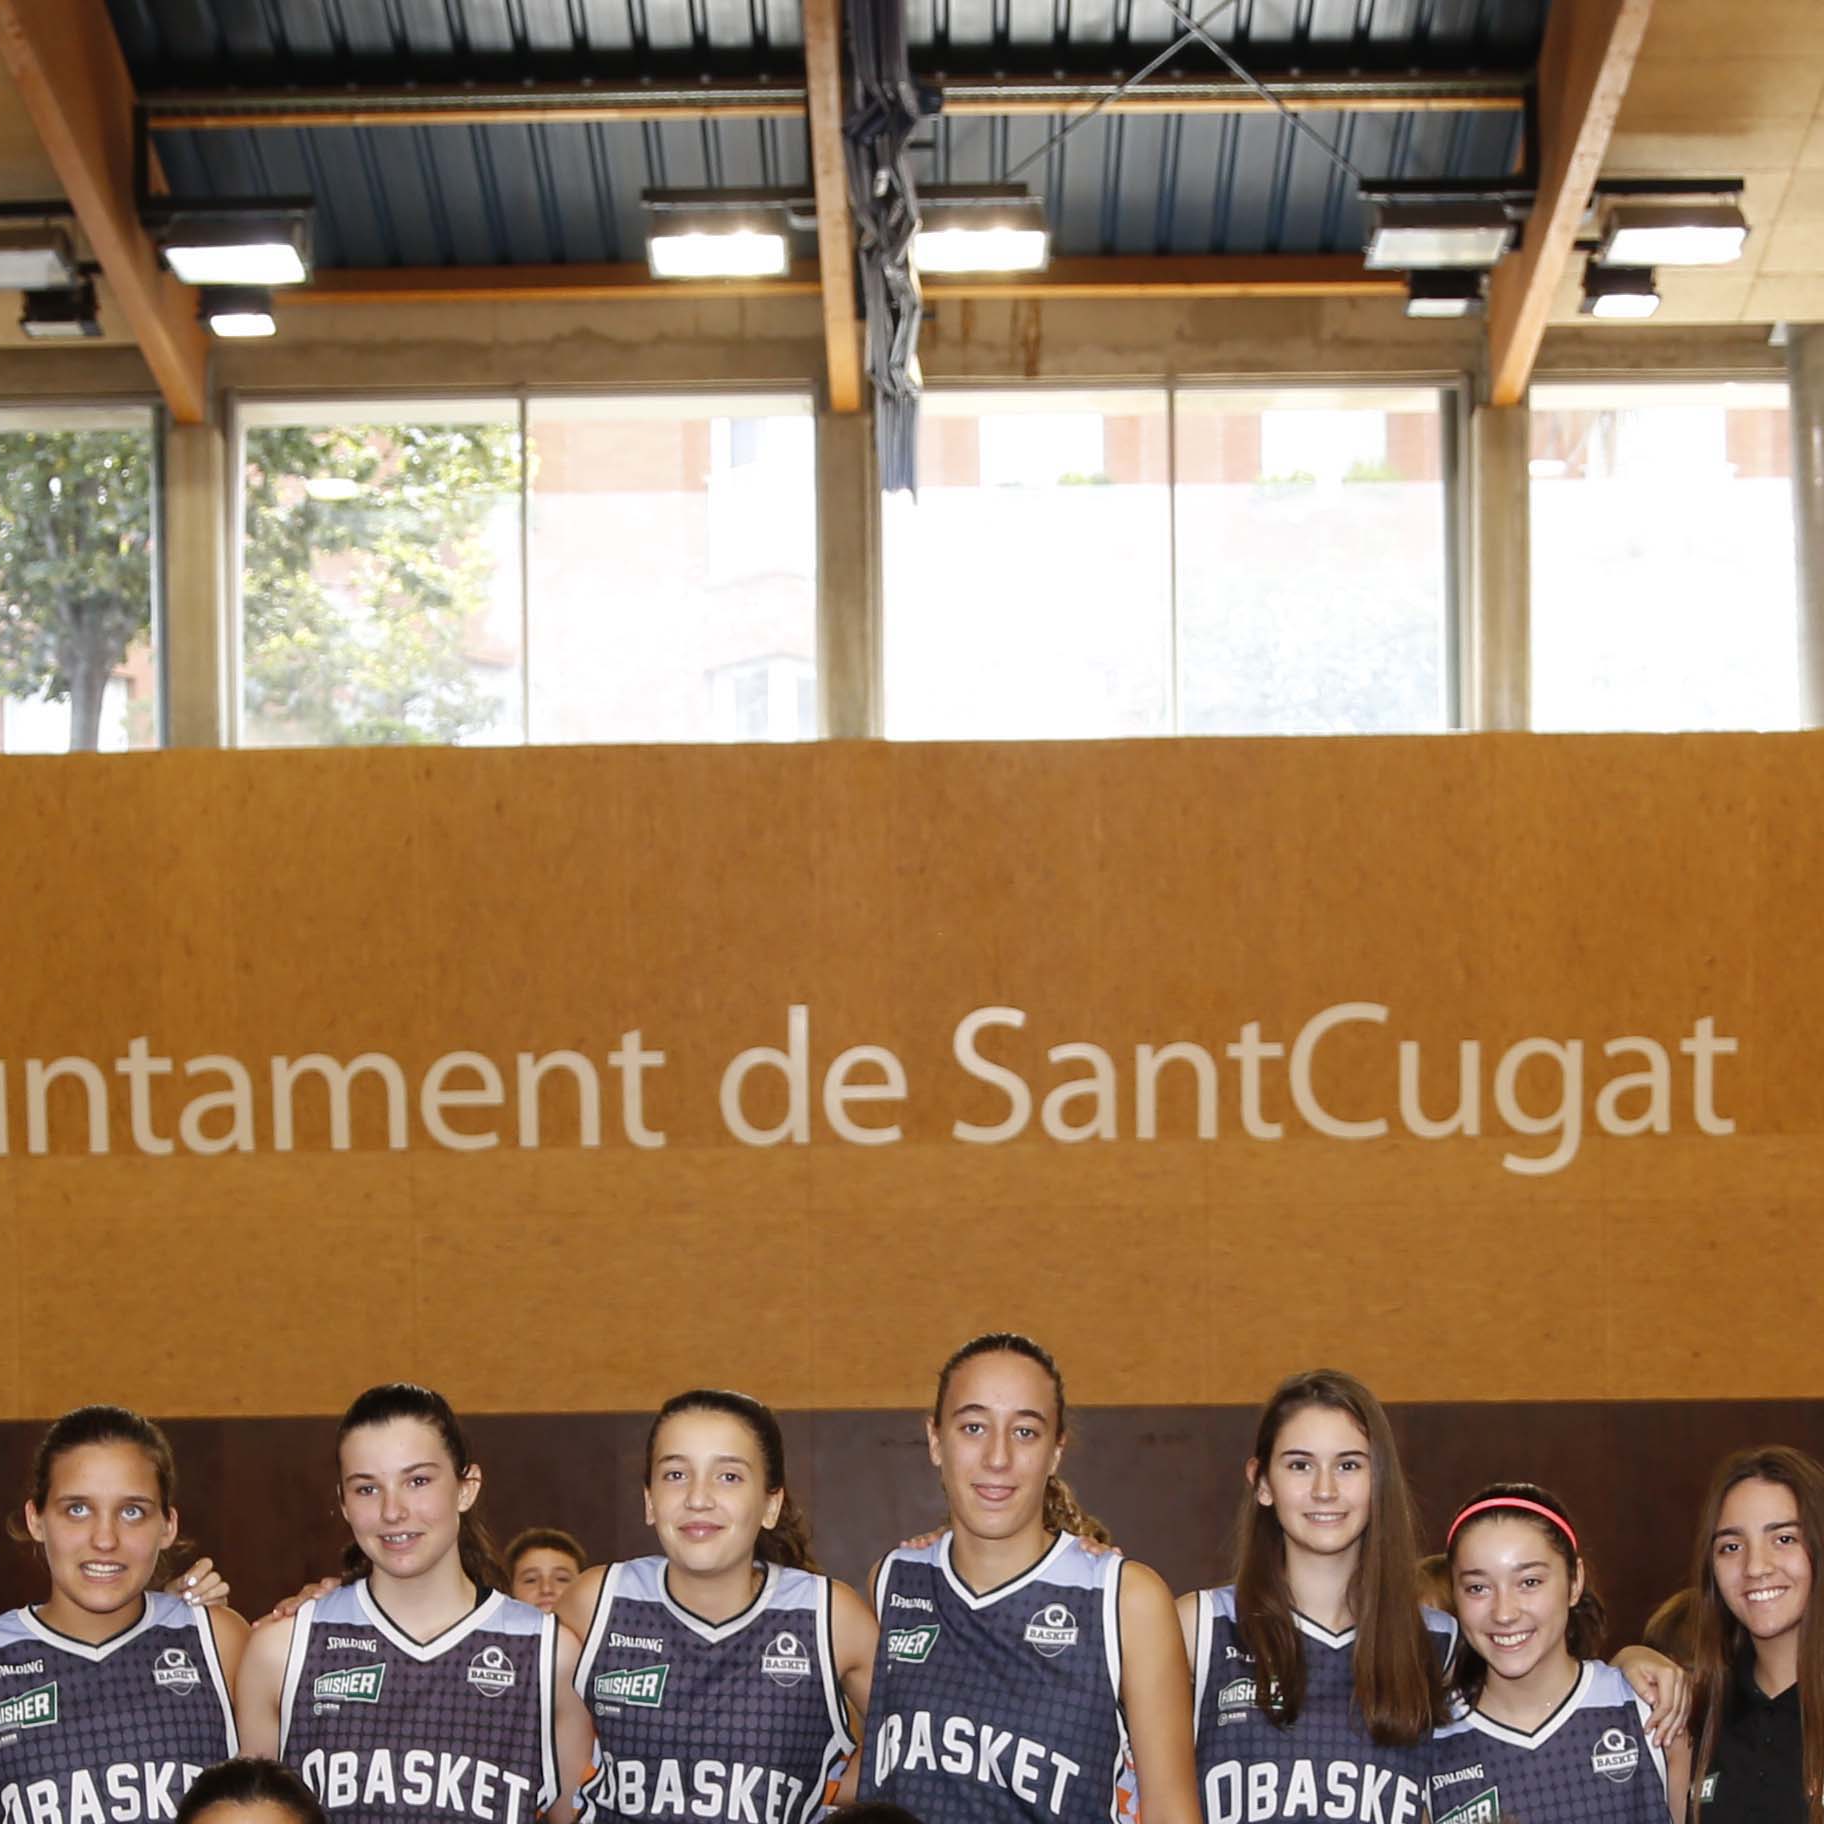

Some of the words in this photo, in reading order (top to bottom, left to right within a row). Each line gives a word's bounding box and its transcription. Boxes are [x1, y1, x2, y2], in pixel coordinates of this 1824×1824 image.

[718, 1004, 909, 1145] de
[950, 1004, 1739, 1177] SantCugat
[1044, 1603, 1067, 1627] Q
[327, 1637, 376, 1653] SPALDING
[609, 1633, 663, 1653] SPALDING
[777, 1631, 798, 1655] Q
[1029, 1629, 1074, 1641] BASKET
[483, 1647, 504, 1667] Q
[765, 1658, 807, 1671] BASKET
[317, 1673, 376, 1694] FINISHER
[470, 1671, 512, 1684] BASKET
[597, 1672, 658, 1697] FINISHER
[1602, 1728, 1625, 1750] Q
[1432, 1763, 1484, 1791] SPALDING
